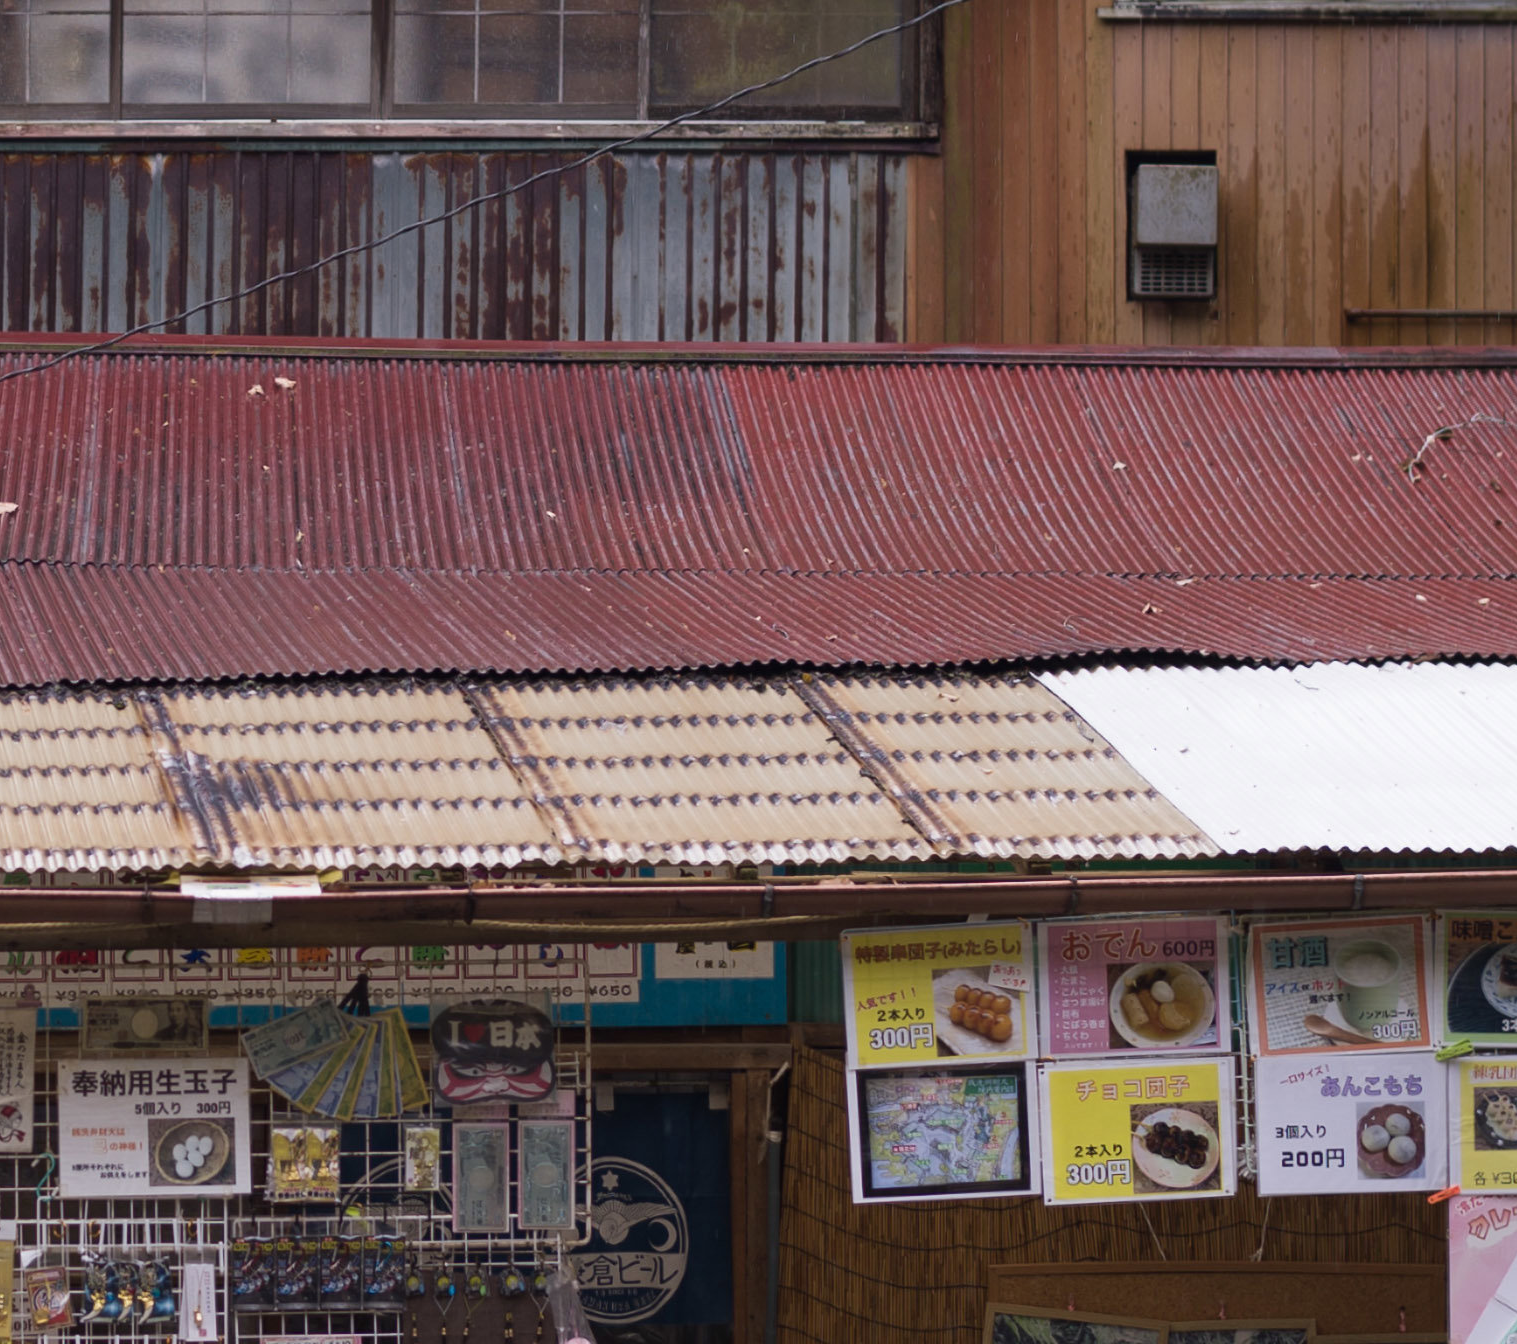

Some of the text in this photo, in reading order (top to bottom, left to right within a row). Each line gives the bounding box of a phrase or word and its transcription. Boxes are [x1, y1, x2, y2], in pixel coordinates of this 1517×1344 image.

[854, 941, 1021, 964] 特製串団子(みたらし)
[1060, 928, 1216, 962] おでん 600円
[1267, 936, 1329, 969] 甘酒
[1060, 985, 1105, 997] こんにゃく
[876, 1007, 926, 1023] 2本入り
[1357, 1007, 1416, 1020] ノンアルコール
[489, 1018, 542, 1049] 日本
[869, 1023, 934, 1050] 300円
[1062, 1030, 1090, 1041] ちくわ
[1372, 1018, 1420, 1040] 300円
[71, 1069, 237, 1098] 奉納用生玉子
[1076, 1076, 1191, 1103] チョコ団子
[1320, 1073, 1424, 1099] あんこもち
[134, 1100, 232, 1115] 5個入り 300円
[1275, 1124, 1328, 1140] 3個入り
[1073, 1143, 1123, 1158] 2本入り
[1281, 1147, 1346, 1170] 200円
[1066, 1159, 1132, 1186] 300円
[1474, 1172, 1486, 1186] 各
[576, 1254, 679, 1286] 倉ビール
